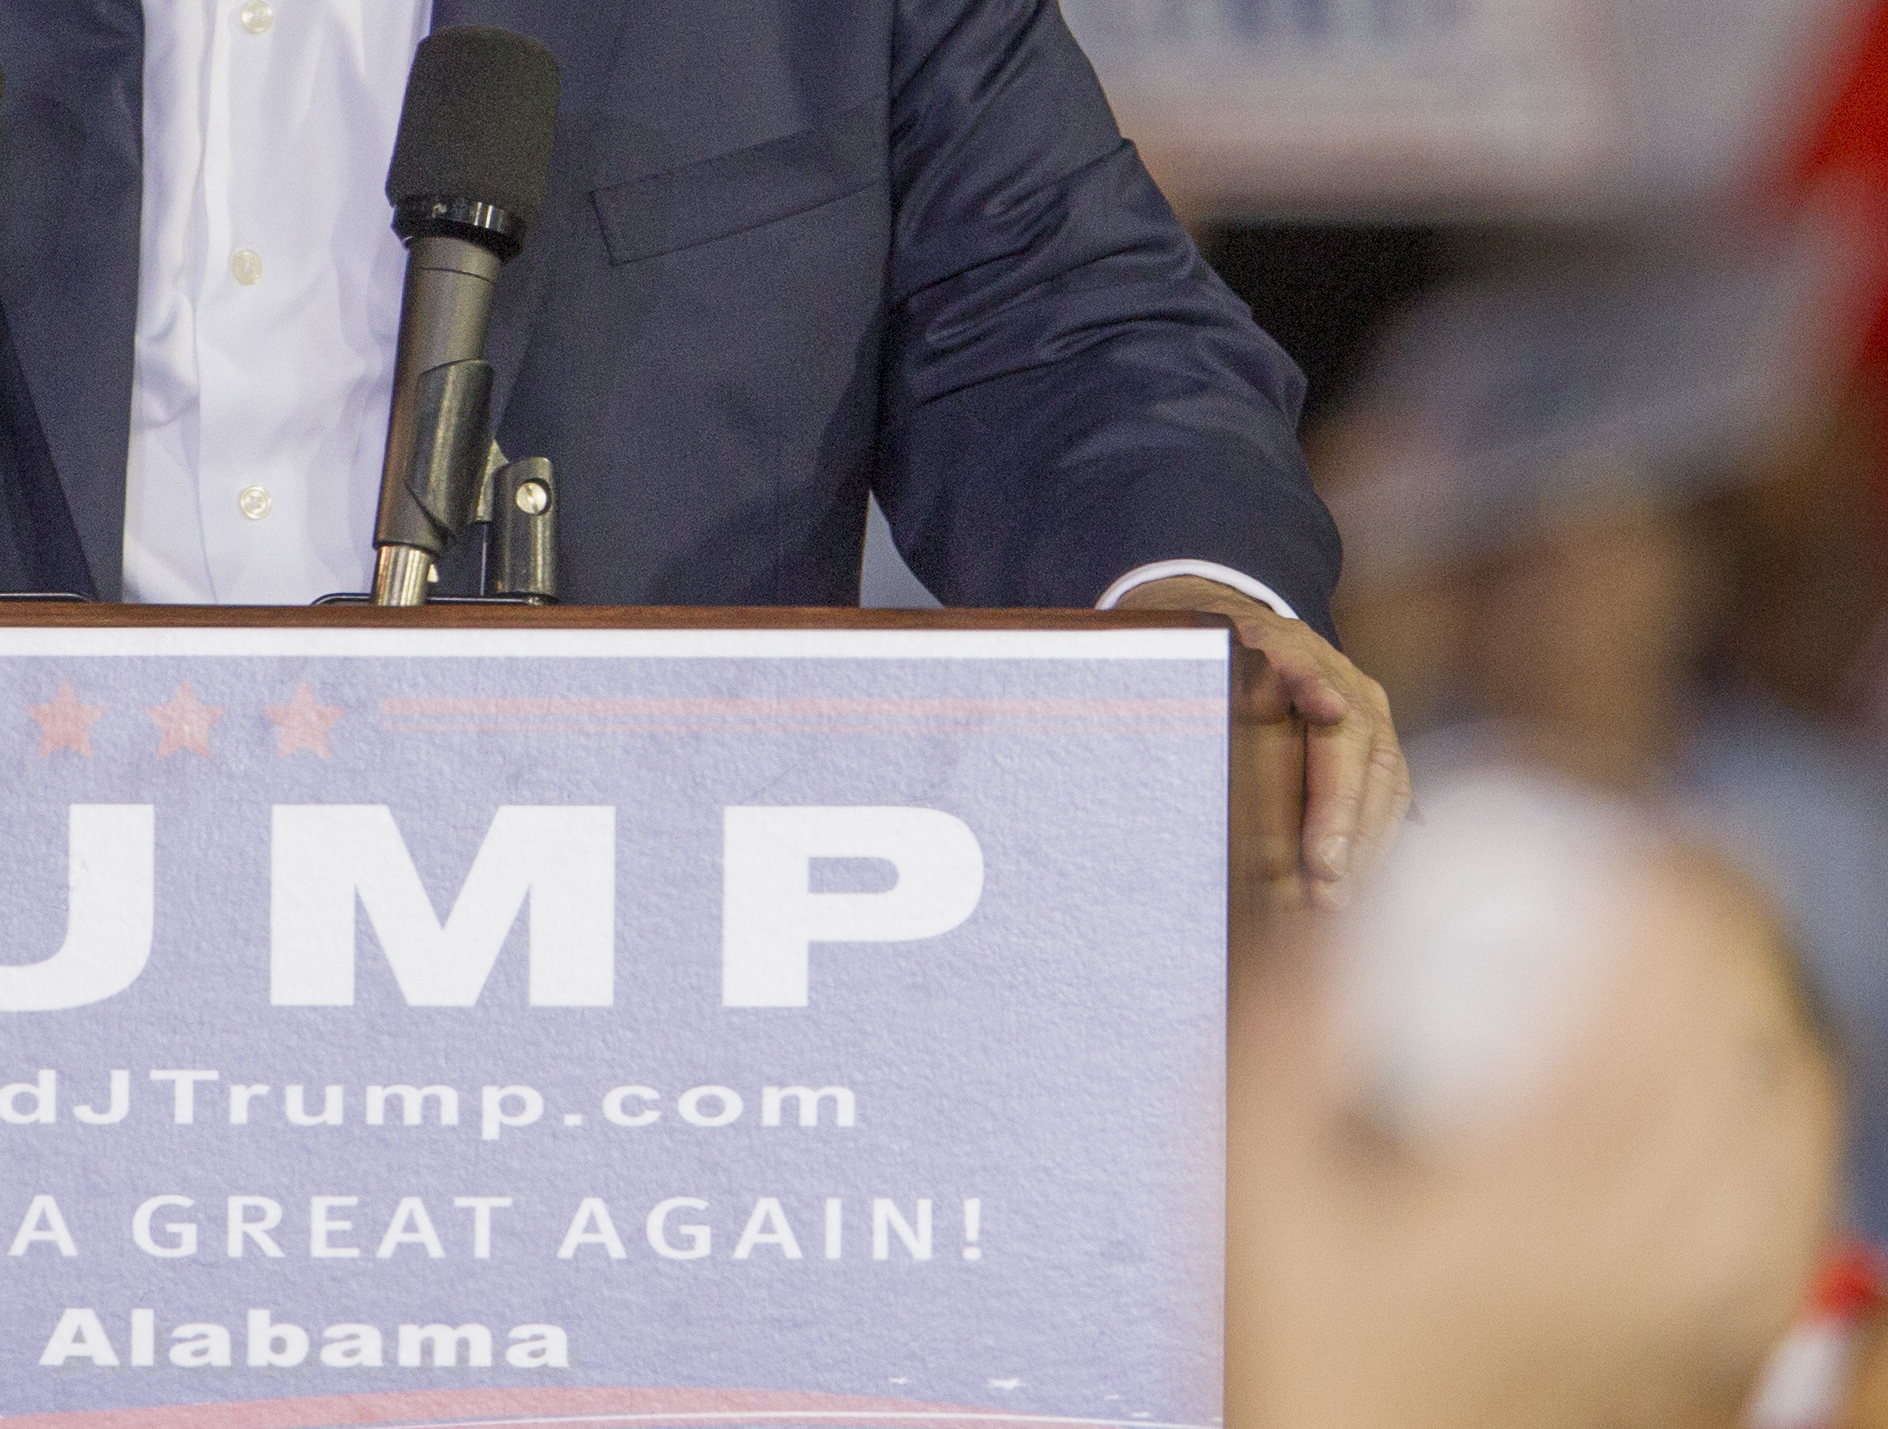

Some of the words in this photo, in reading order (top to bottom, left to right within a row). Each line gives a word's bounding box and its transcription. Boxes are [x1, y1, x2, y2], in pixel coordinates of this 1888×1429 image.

[131, 1194, 514, 1260] GREAT
[556, 1196, 984, 1262] AGAIN!
[38, 1307, 571, 1369] Alabama
